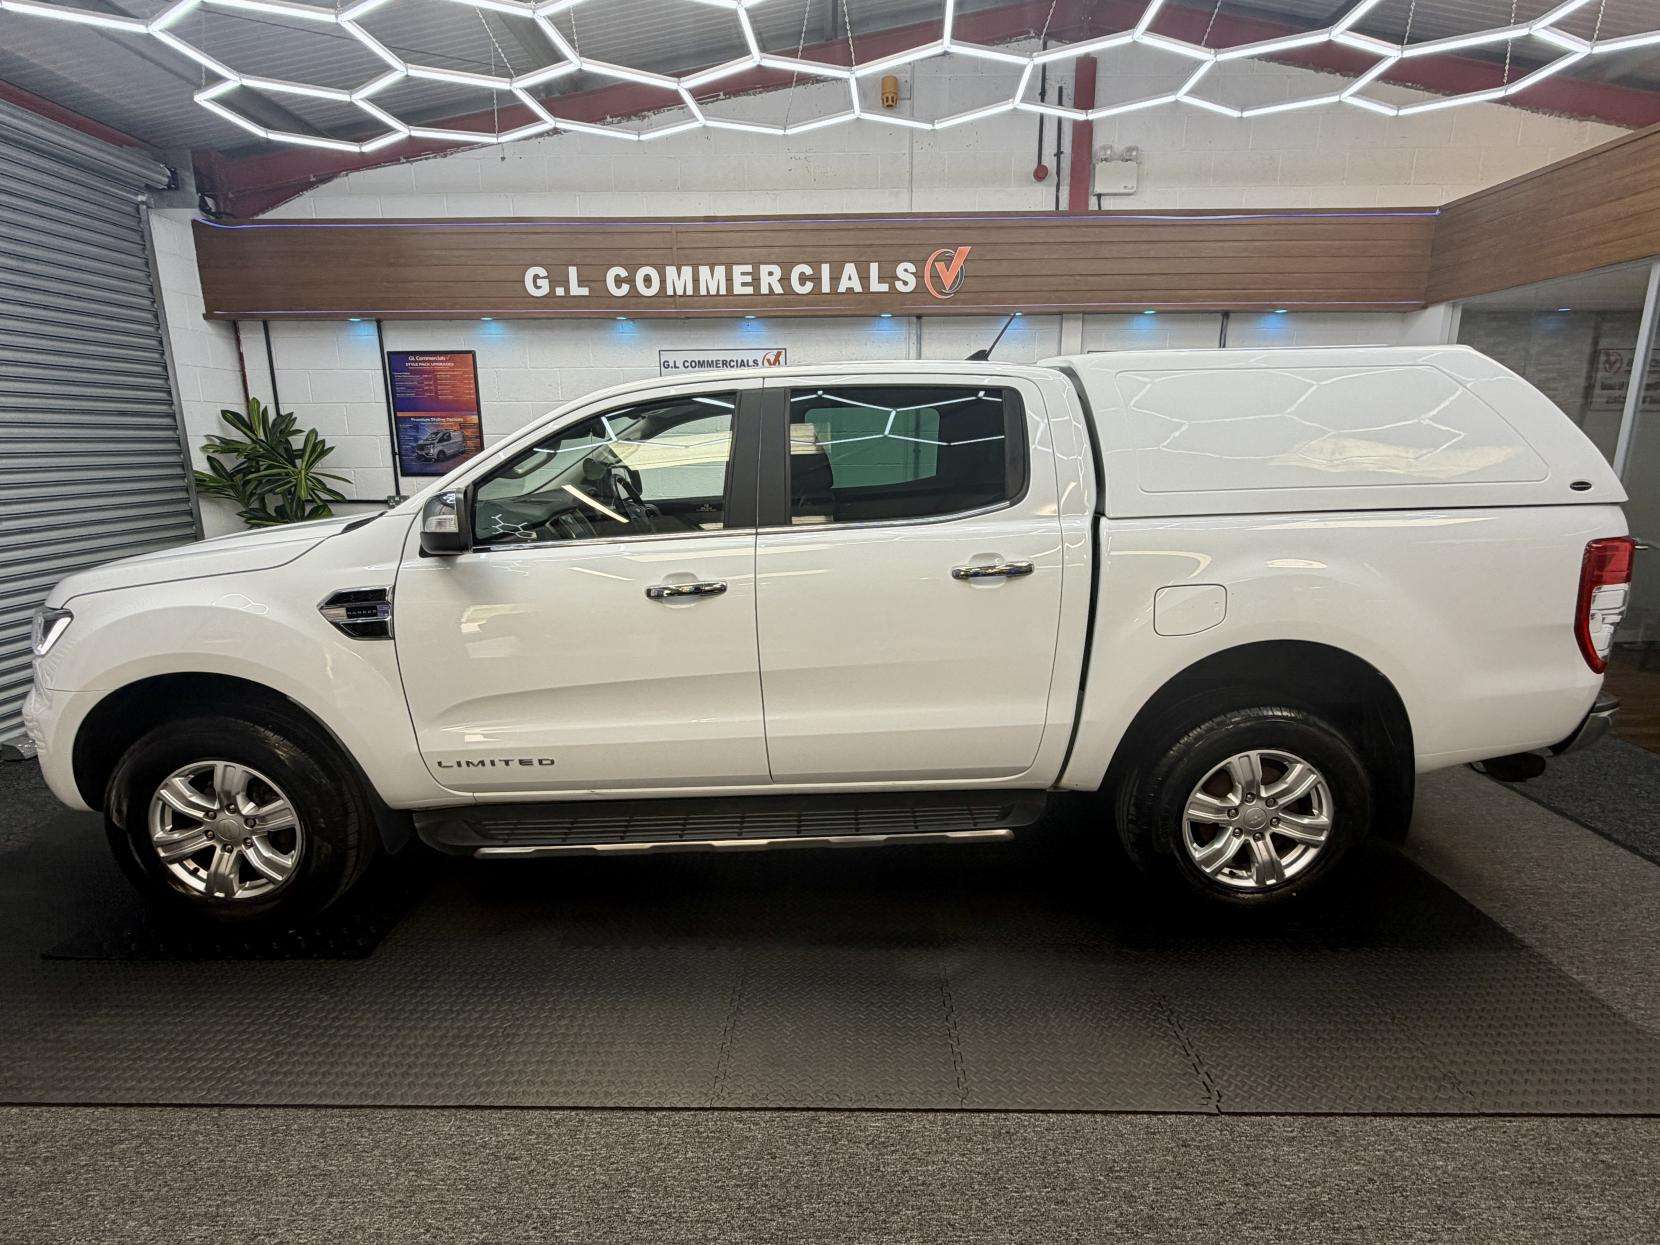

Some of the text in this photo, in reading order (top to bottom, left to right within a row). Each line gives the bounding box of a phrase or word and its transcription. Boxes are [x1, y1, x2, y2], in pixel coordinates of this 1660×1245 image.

[524, 262, 917, 297] G.L COMMERCIALS
[662, 359, 759, 369] G.L COMMERCIALS
[437, 758, 555, 768] LIMITED
